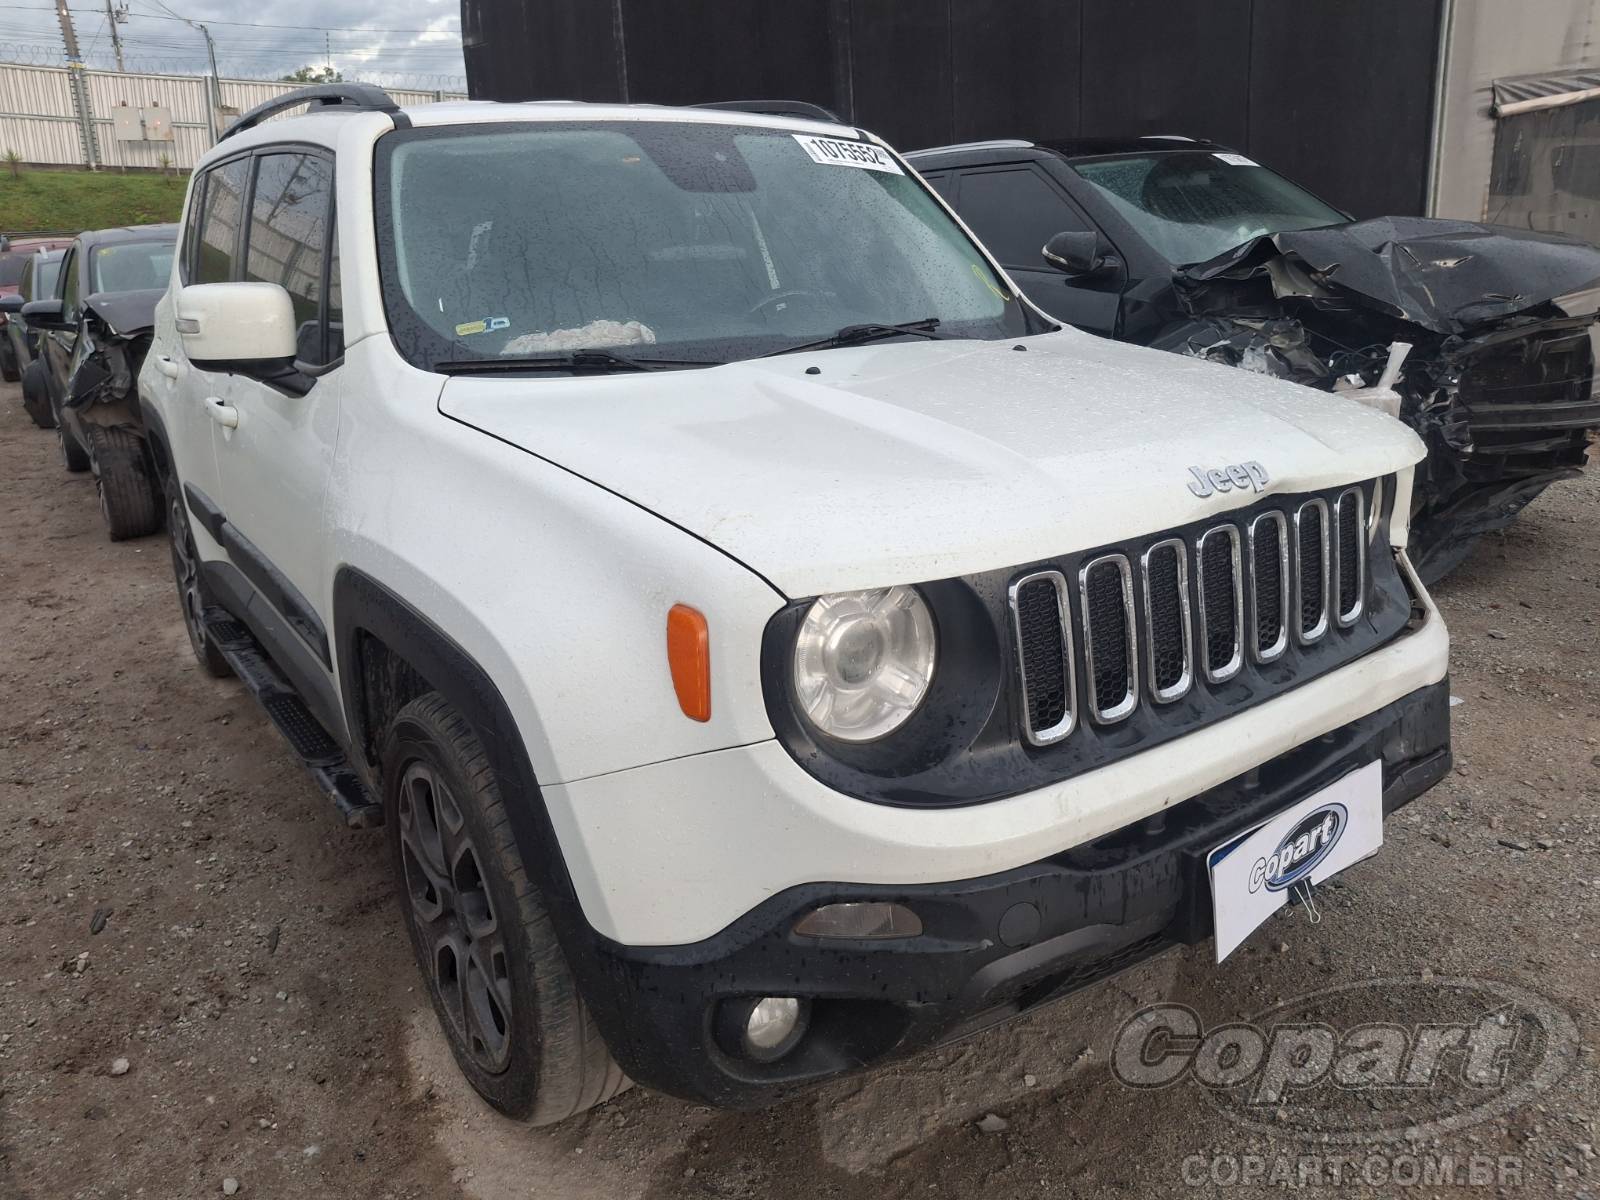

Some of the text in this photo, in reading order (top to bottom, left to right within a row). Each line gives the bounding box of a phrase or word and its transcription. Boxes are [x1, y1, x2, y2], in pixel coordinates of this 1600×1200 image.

[810, 139, 886, 165] 1075552
[1187, 461, 1269, 498] Jeep
[1249, 811, 1335, 894] Copart
